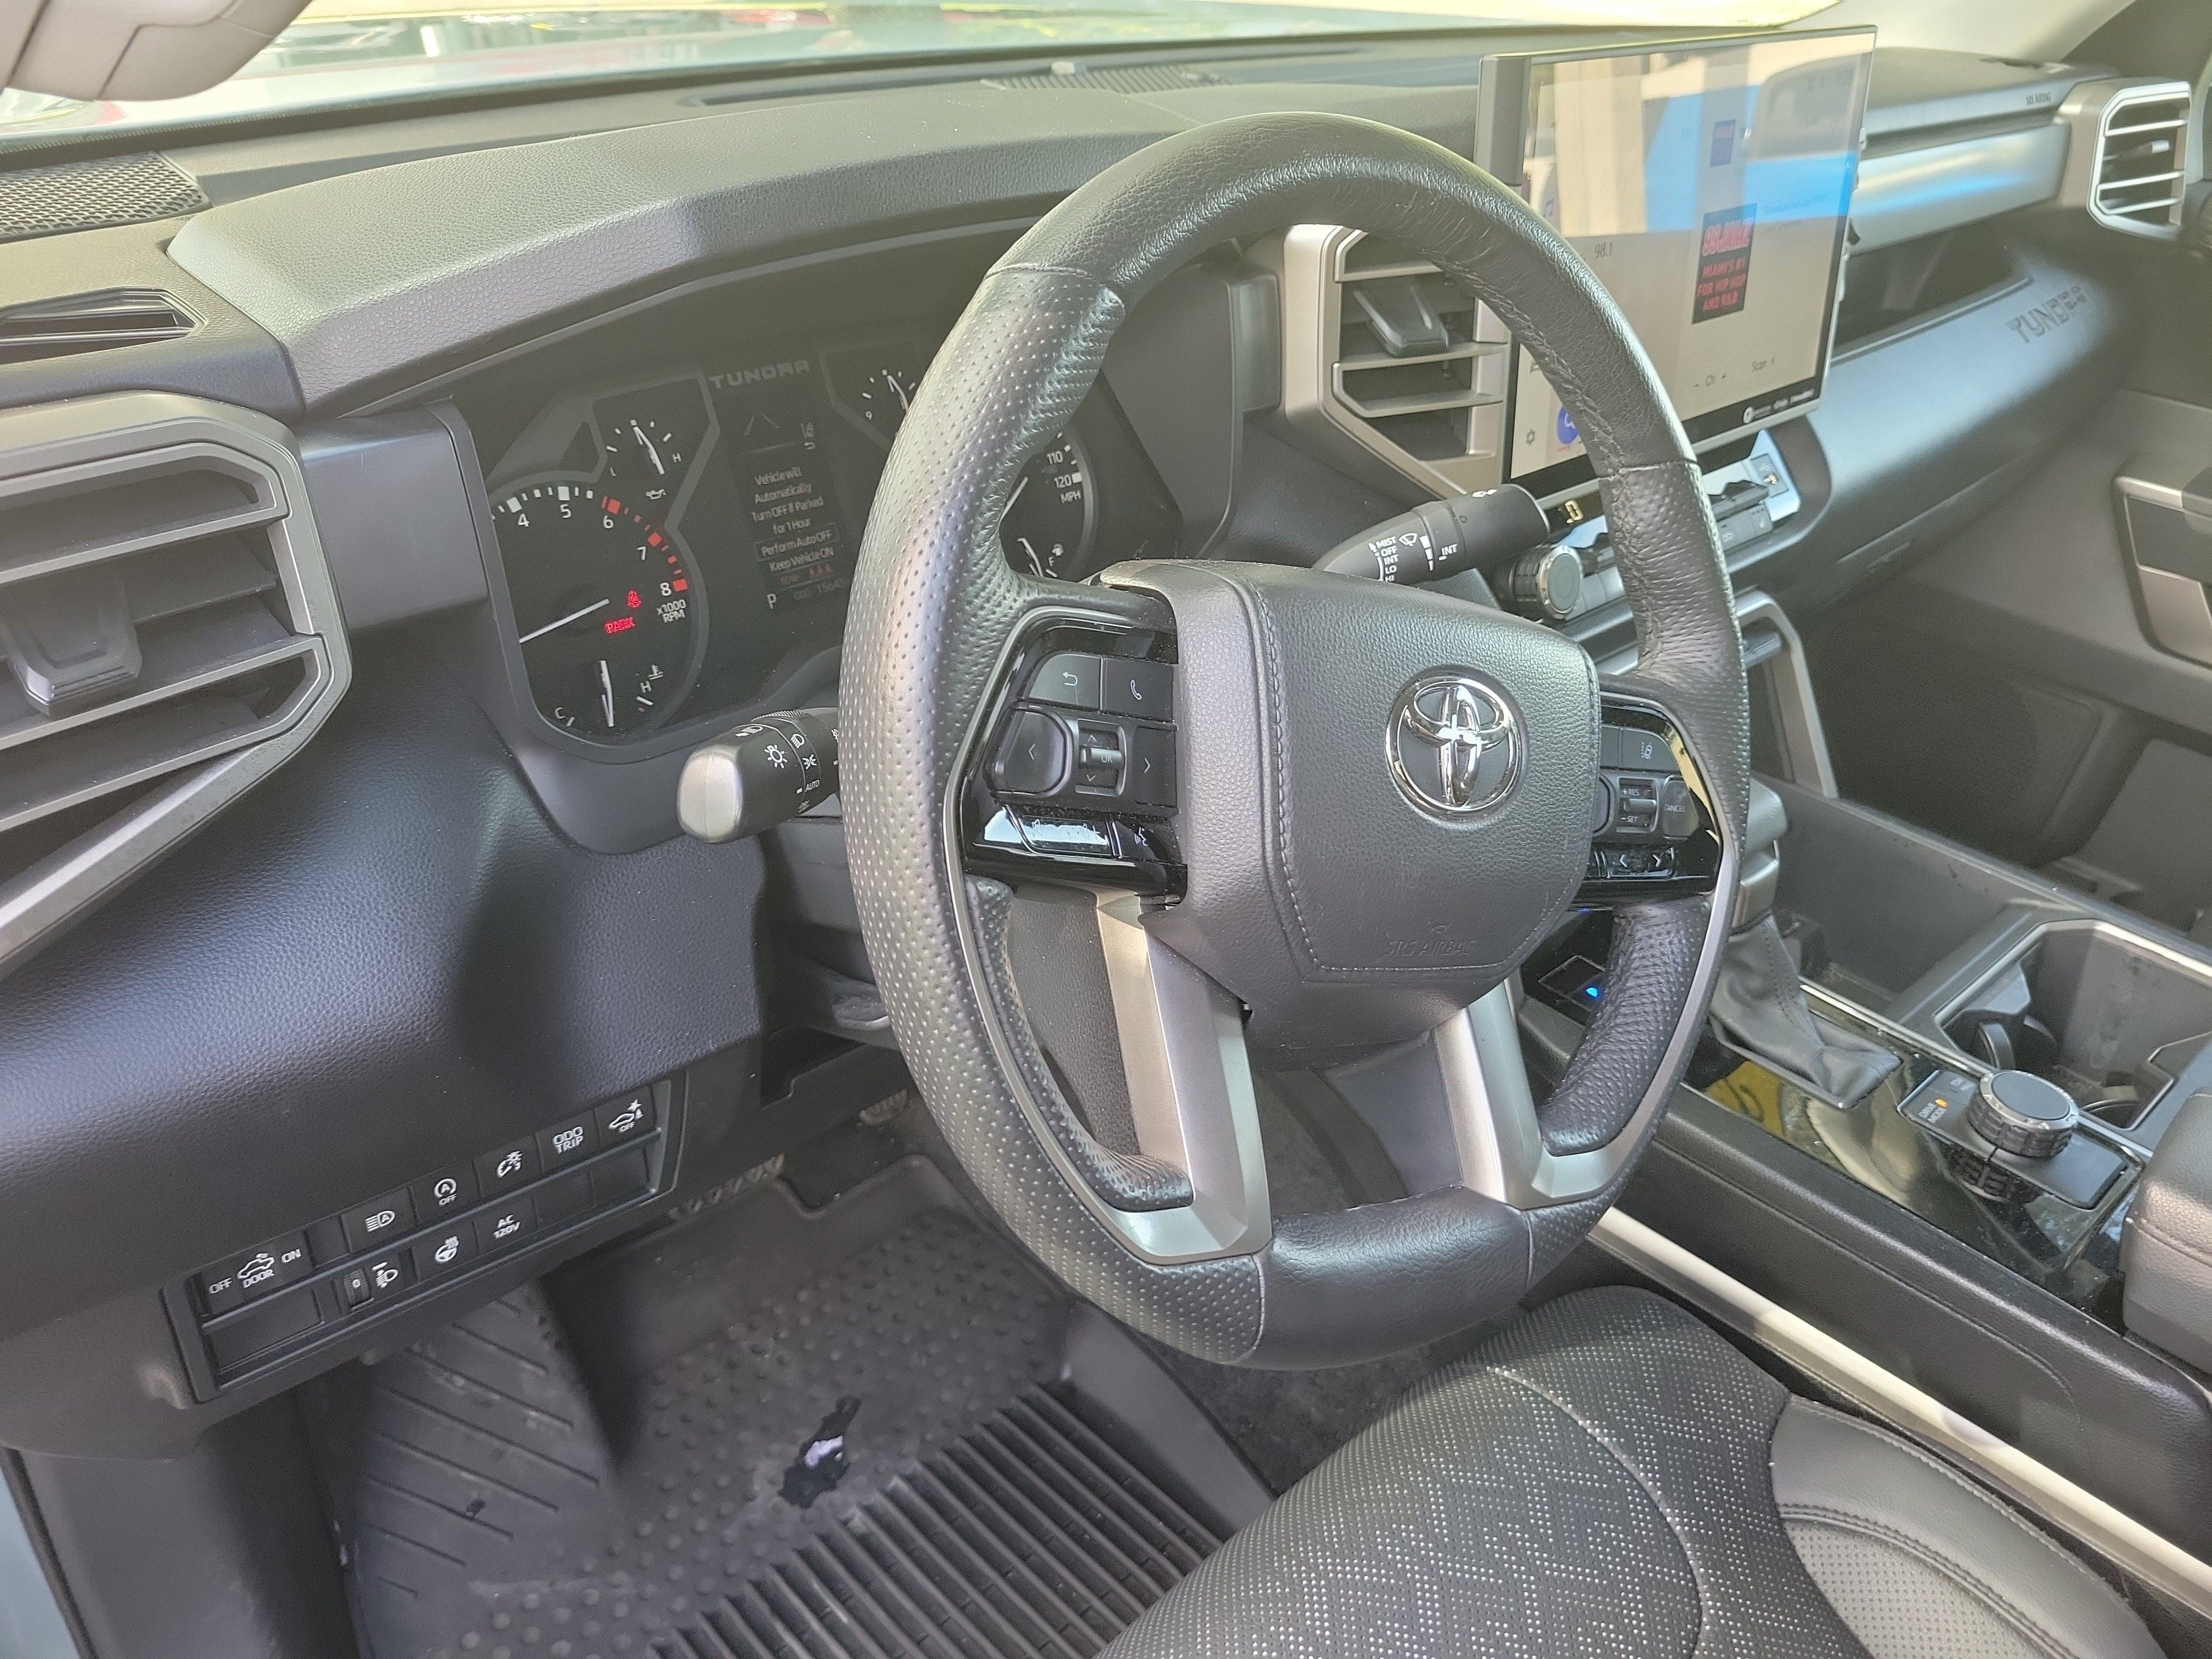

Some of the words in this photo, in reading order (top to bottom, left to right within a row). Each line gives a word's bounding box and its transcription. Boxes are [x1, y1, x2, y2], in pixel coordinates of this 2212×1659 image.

[1594, 242, 1612, 259] 98.1
[708, 359, 810, 389] TUNDRA
[673, 453, 681, 463] H
[1047, 450, 1063, 465] 110
[610, 467, 617, 476] L
[755, 471, 785, 486] Vehicle
[1054, 474, 1071, 489] 120
[755, 483, 812, 504] Automatically
[1060, 490, 1081, 504] MPH
[560, 504, 572, 518] 5
[752, 511, 771, 522] Turn
[771, 505, 787, 517] OFF
[794, 496, 823, 511] Parked
[518, 514, 529, 527] 4
[603, 515, 614, 529] 6
[772, 523, 785, 535] for
[793, 518, 810, 530] Hour
[761, 541, 796, 556] Perform
[796, 535, 816, 548] Auto
[816, 529, 831, 542] OFF
[1375, 536, 1396, 549] MIST
[1442, 543, 1458, 556] INT
[637, 546, 647, 561] 7
[1380, 545, 1397, 557] OFF
[770, 560, 791, 572] Keep
[791, 551, 821, 565] Vehicle
[821, 546, 834, 558] ON
[1383, 554, 1398, 565] INT
[1385, 565, 1397, 574] LO
[660, 582, 672, 596] 8
[657, 599, 686, 616] x1000
[768, 593, 776, 610] P
[663, 609, 685, 623] RPM
[605, 617, 635, 634] PARK
[640, 680, 651, 693] H
[555, 707, 565, 719] C
[1101, 753, 1113, 764] OK
[805, 780, 820, 792] AUTO
[1664, 804, 1685, 812] CANCEL
[1384, 940, 1418, 958] SRS
[1418, 940, 1477, 957] AIRBAG
[618, 1121, 636, 1133] OFF
[552, 1126, 584, 1146] ODO
[555, 1135, 584, 1154] TRIP
[439, 1193, 458, 1205] OFF
[497, 1214, 515, 1229] AC
[493, 1221, 521, 1239] 120V
[208, 1277, 233, 1294] OFF
[281, 1248, 301, 1263] ON
[242, 1269, 274, 1288] DOOR
[352, 1279, 360, 1289] 0
